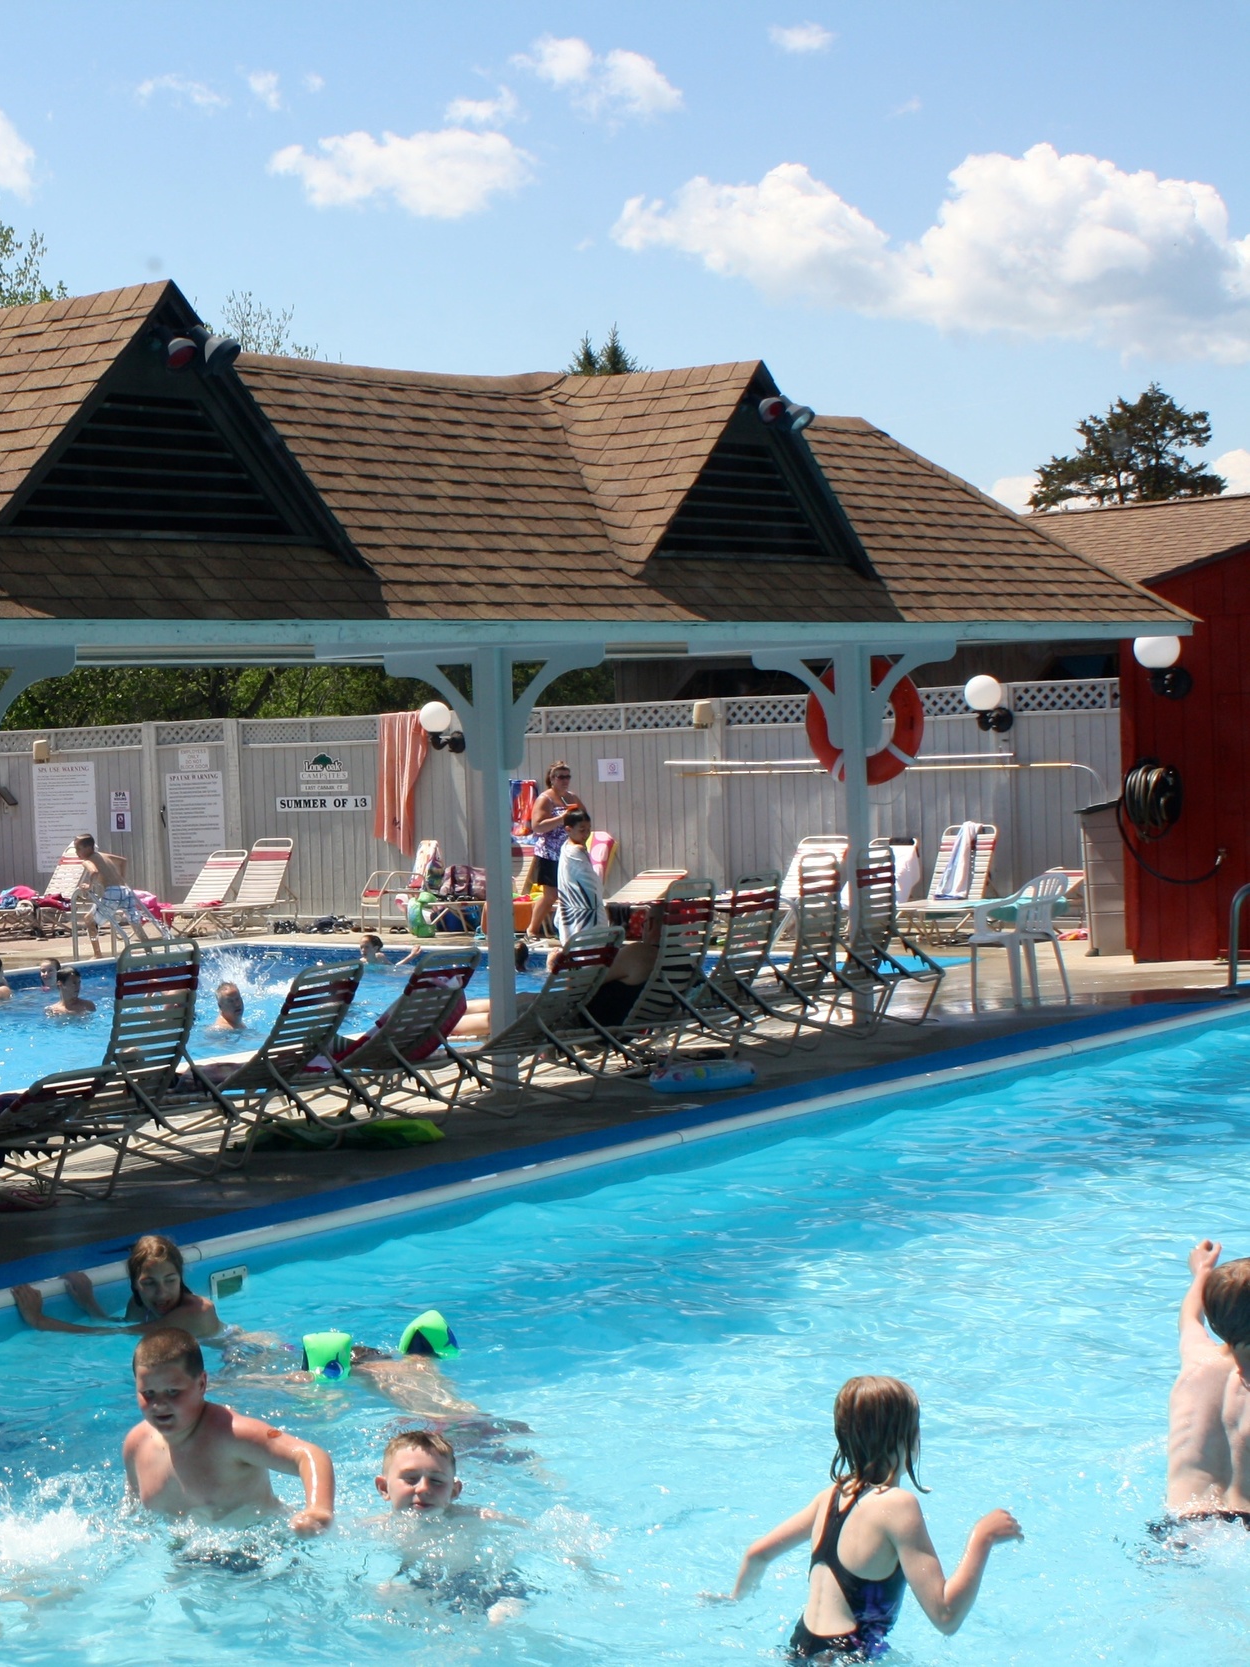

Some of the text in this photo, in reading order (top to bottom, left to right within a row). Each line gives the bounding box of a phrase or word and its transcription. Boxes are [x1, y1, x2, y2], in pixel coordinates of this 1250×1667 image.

[304, 761, 323, 772] Lone
[280, 798, 367, 808] SUMMER OF 13
